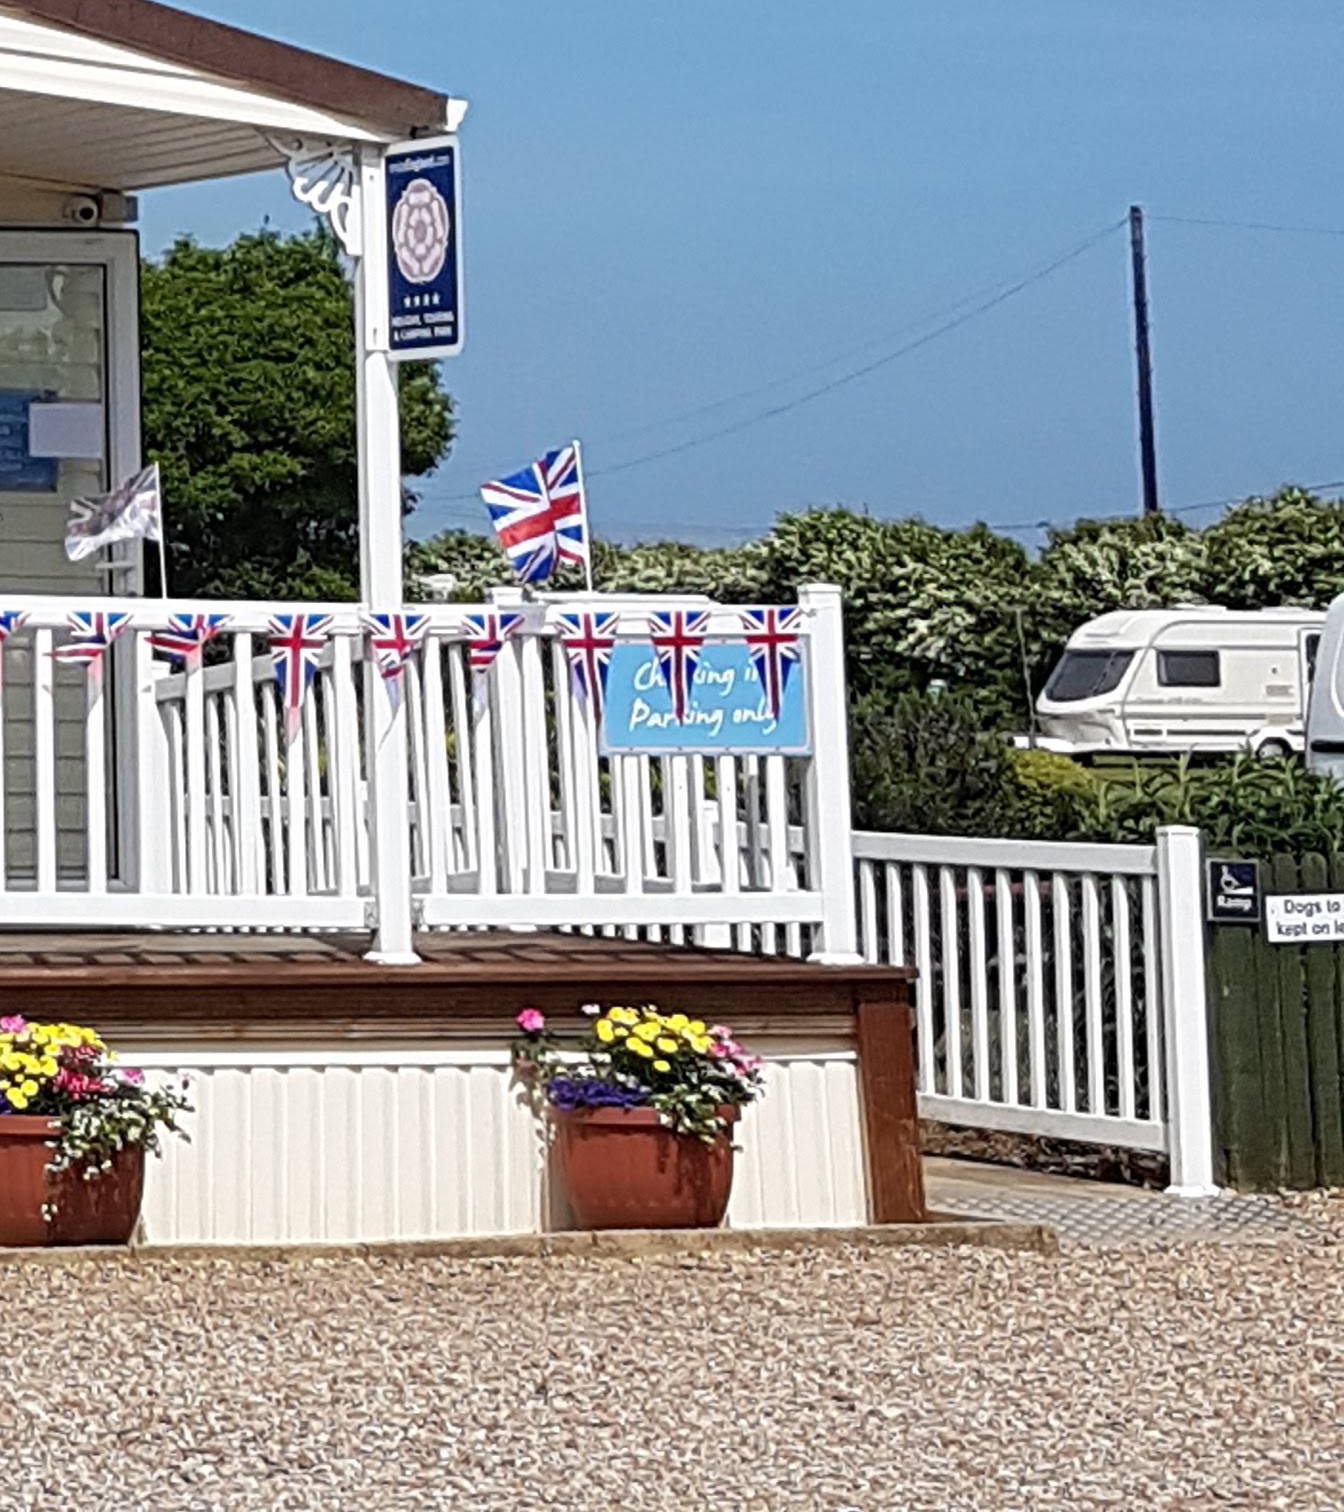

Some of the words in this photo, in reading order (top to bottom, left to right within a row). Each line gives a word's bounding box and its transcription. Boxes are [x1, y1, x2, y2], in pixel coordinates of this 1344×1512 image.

[1283, 899, 1322, 918] Dogs
[1326, 899, 1341, 913] to
[1276, 921, 1308, 937] kept
[1312, 924, 1330, 935] on
